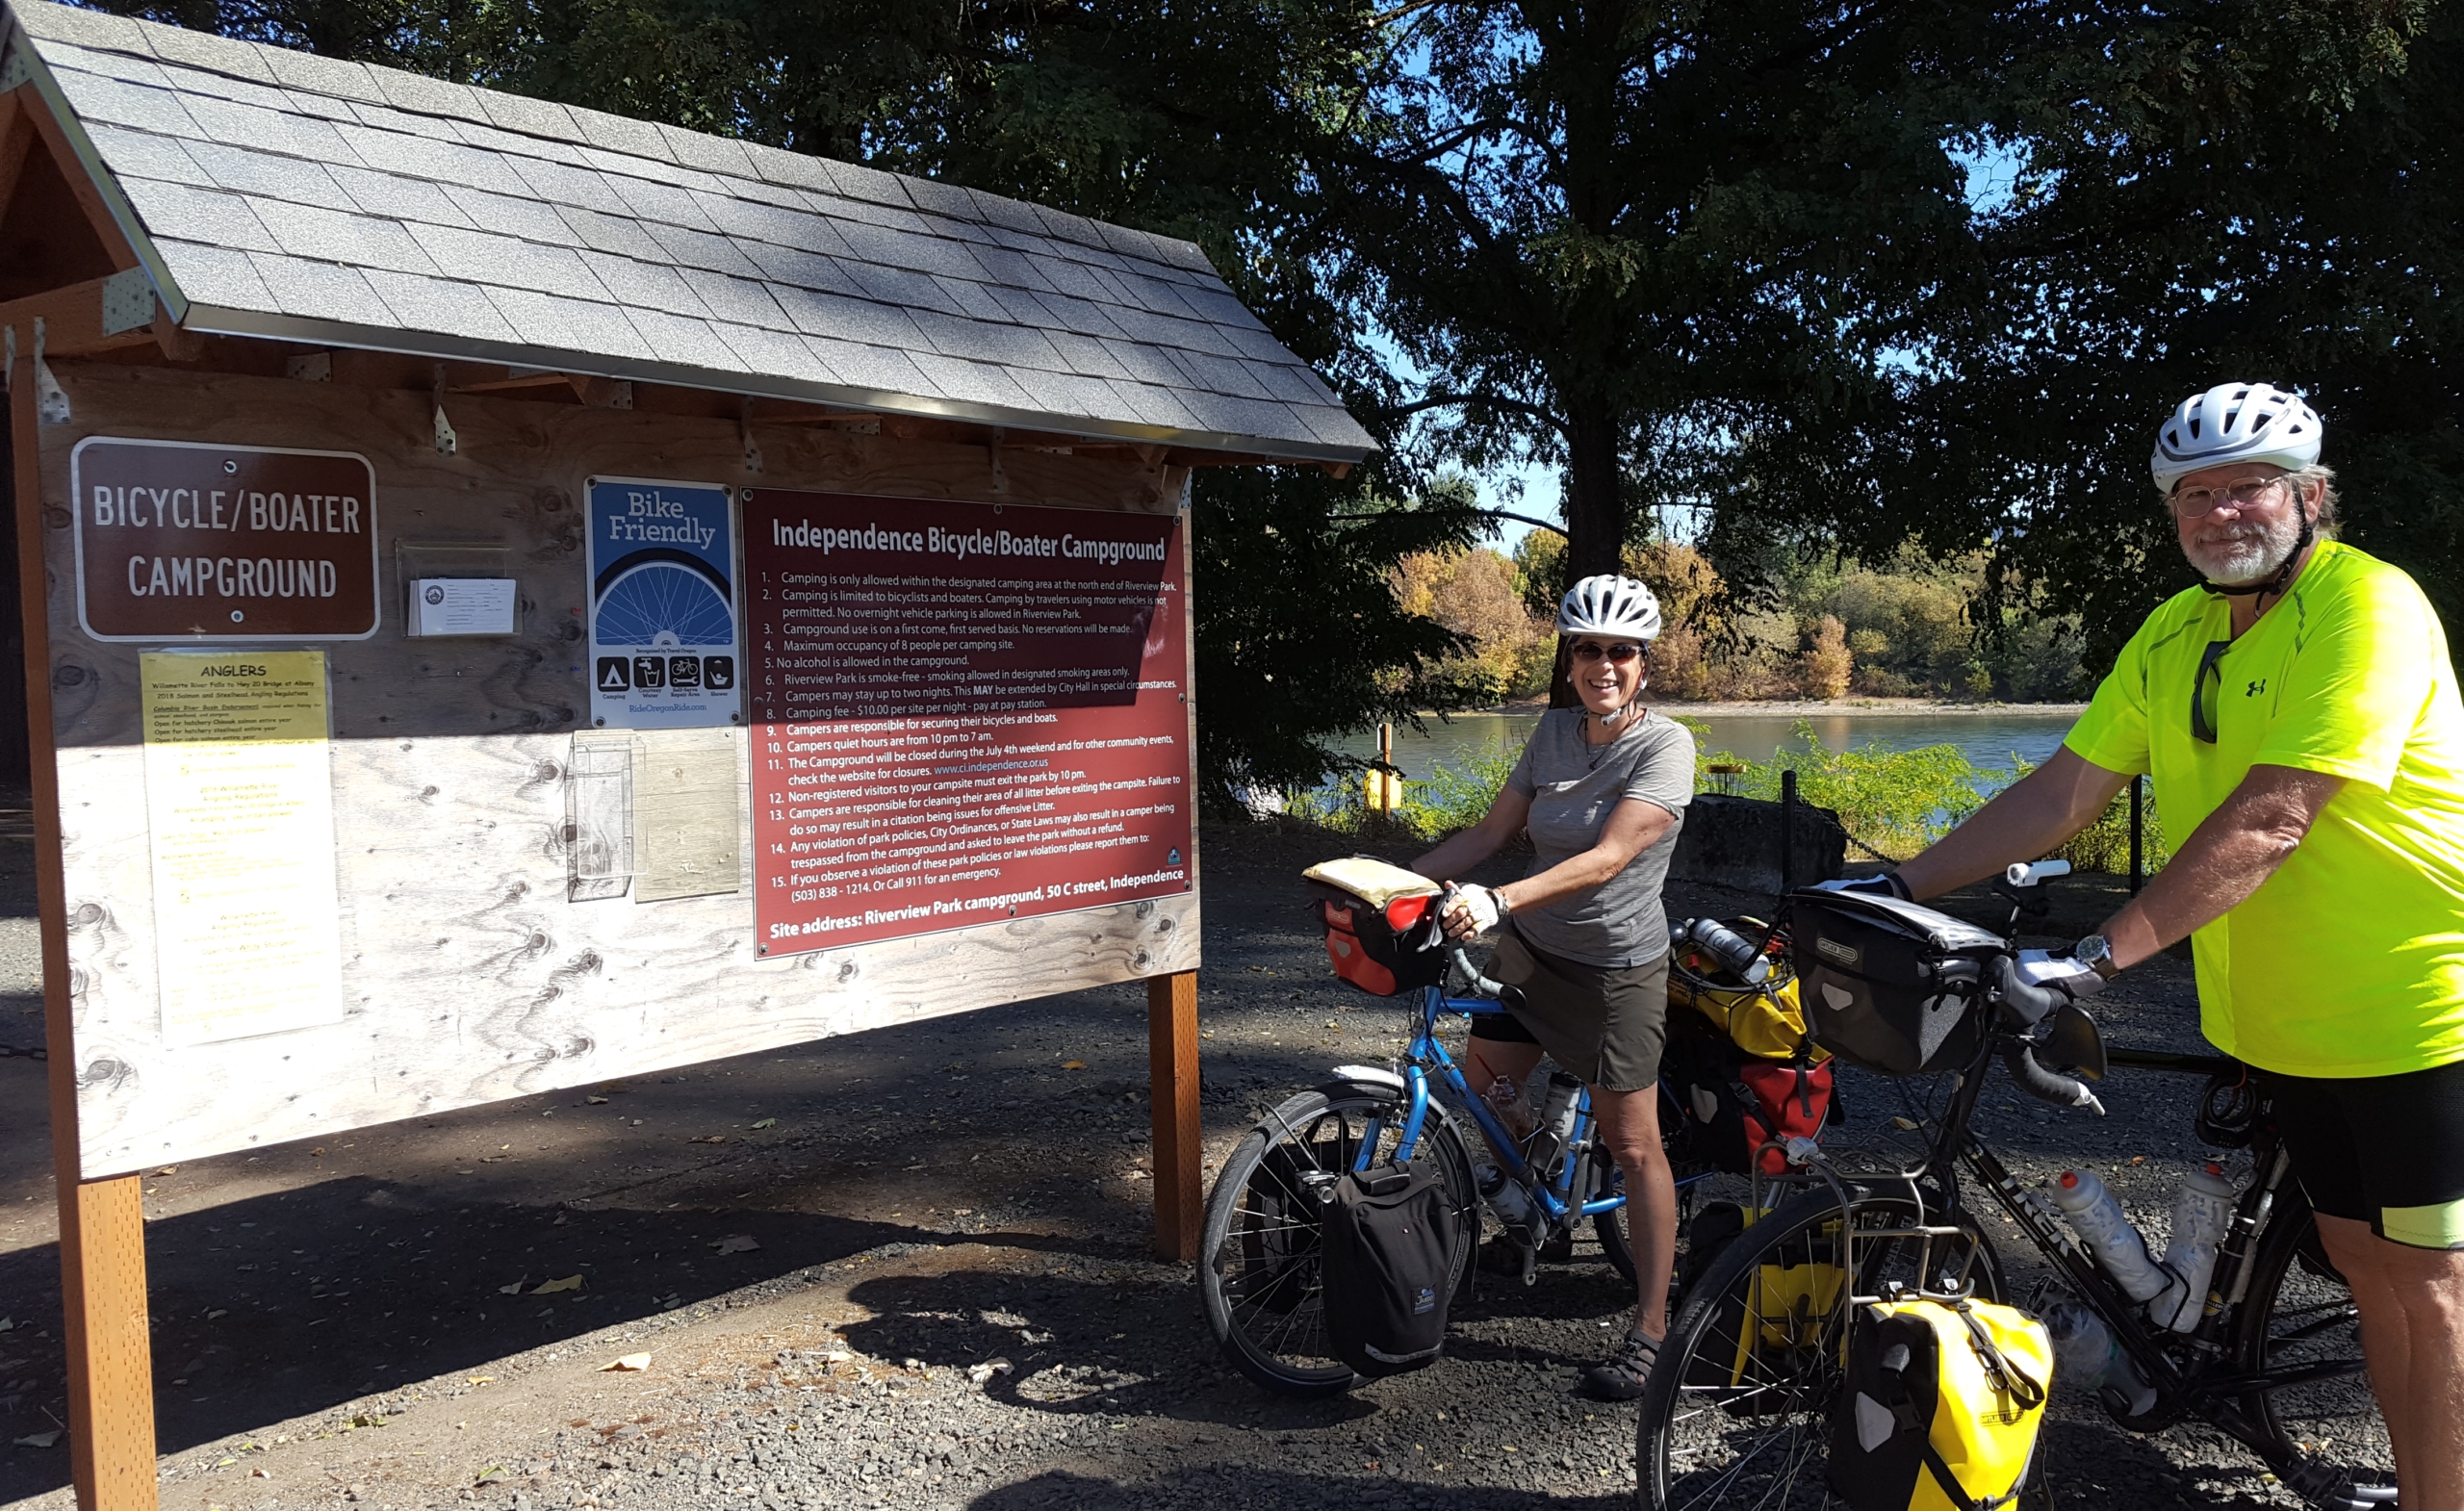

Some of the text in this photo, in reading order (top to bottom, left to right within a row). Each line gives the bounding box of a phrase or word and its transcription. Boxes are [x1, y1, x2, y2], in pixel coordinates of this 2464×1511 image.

[93, 485, 360, 534] BICYCLE/BOATER
[628, 491, 684, 519] Bike
[609, 515, 716, 551] Friendly
[773, 519, 1165, 564] Independence Bicycle/Boater Campground
[128, 555, 337, 599] CAMPGROUND
[762, 572, 1176, 591] 1. Camping is only allowed within the designated camping area at the north end of Riverview Park.
[764, 639, 1014, 653] 4. Maximum occupancy of 8 people per camping site.
[200, 665, 267, 678] ANGLERS
[629, 704, 707, 713] RideOregonRide.com
[766, 712, 1058, 737] 9. Campers are responsible for securing their bicycles and boats.
[767, 731, 993, 754] 10. Campers quiet hours are from 10 pm to 7 am.
[787, 758, 1048, 785] check the website for closures. www.ci.independence.or.us
[769, 770, 1086, 804] 12. Non-registered visitors to your campsite must exit the park by 10 pm.
[770, 869, 1184, 939] Site address: Riverview Park campground, 50 C street, Independence
